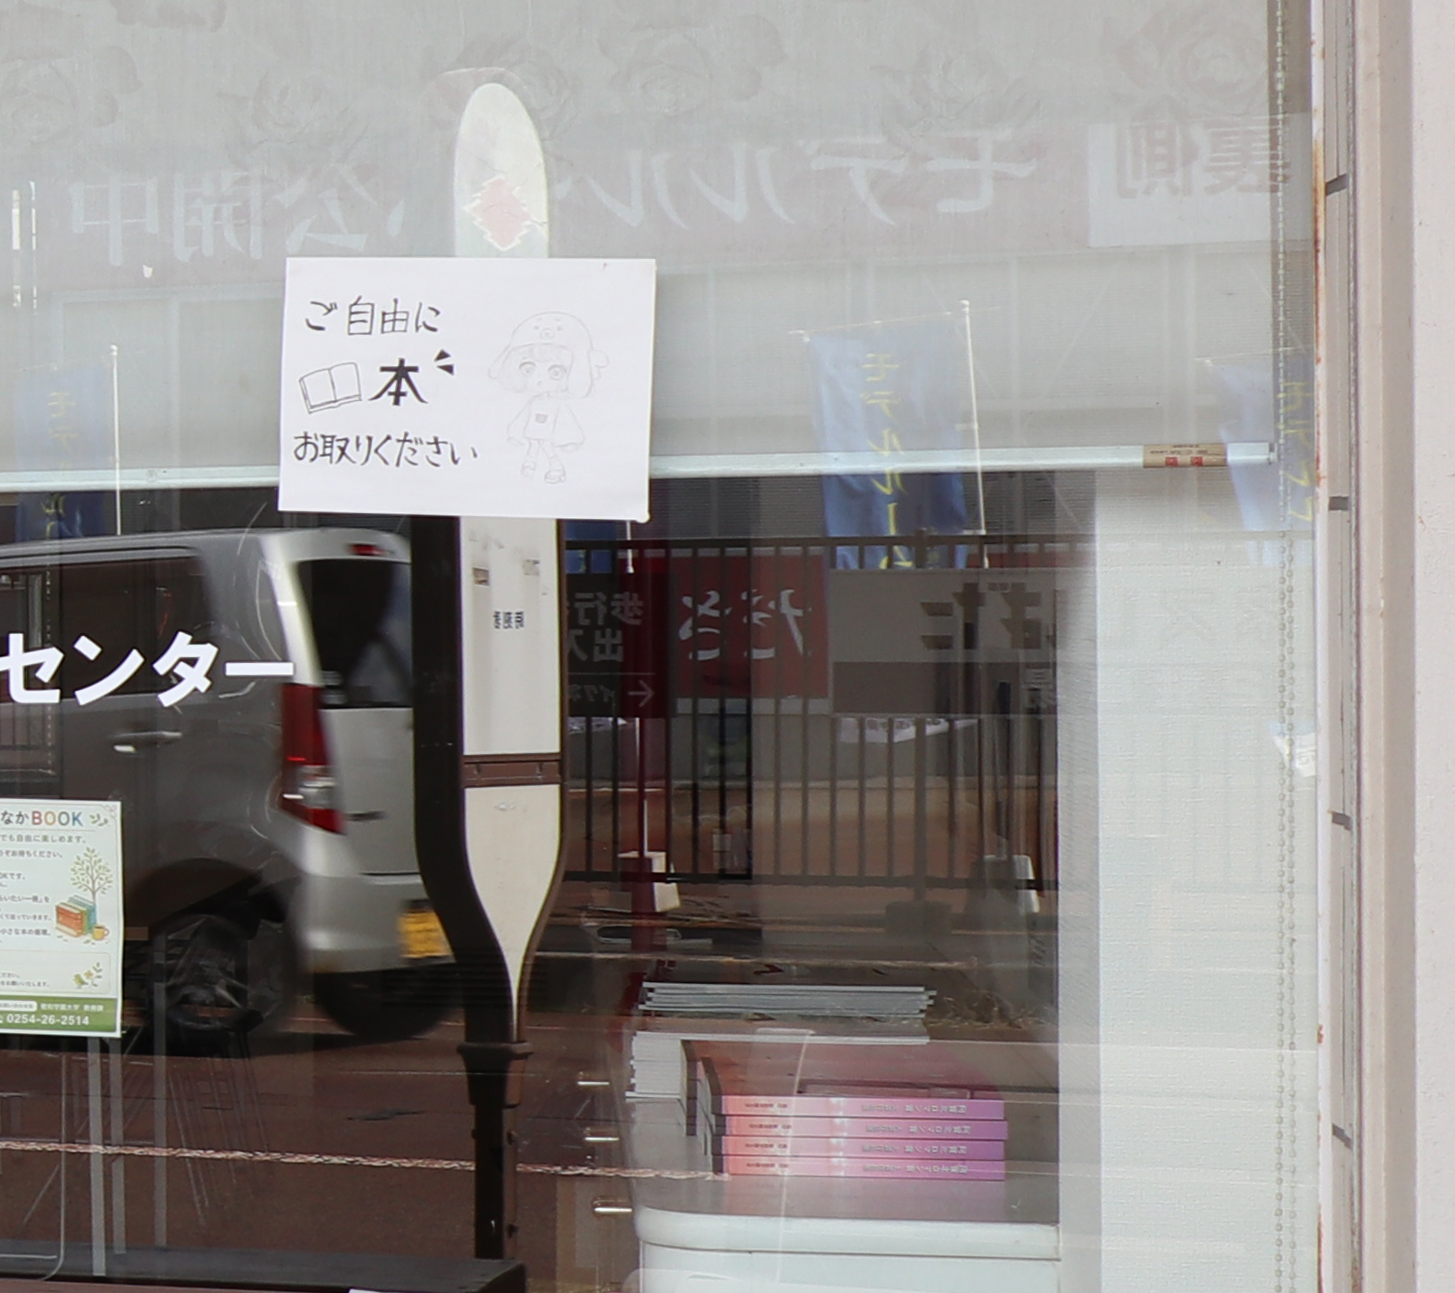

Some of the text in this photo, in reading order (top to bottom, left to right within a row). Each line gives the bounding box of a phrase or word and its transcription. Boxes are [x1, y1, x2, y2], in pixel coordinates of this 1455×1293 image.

[305, 295, 441, 336] ご自由に
[368, 358, 429, 407] 本
[292, 431, 479, 468] お取りください
[5, 1013, 90, 1026] 0254-26-2514
